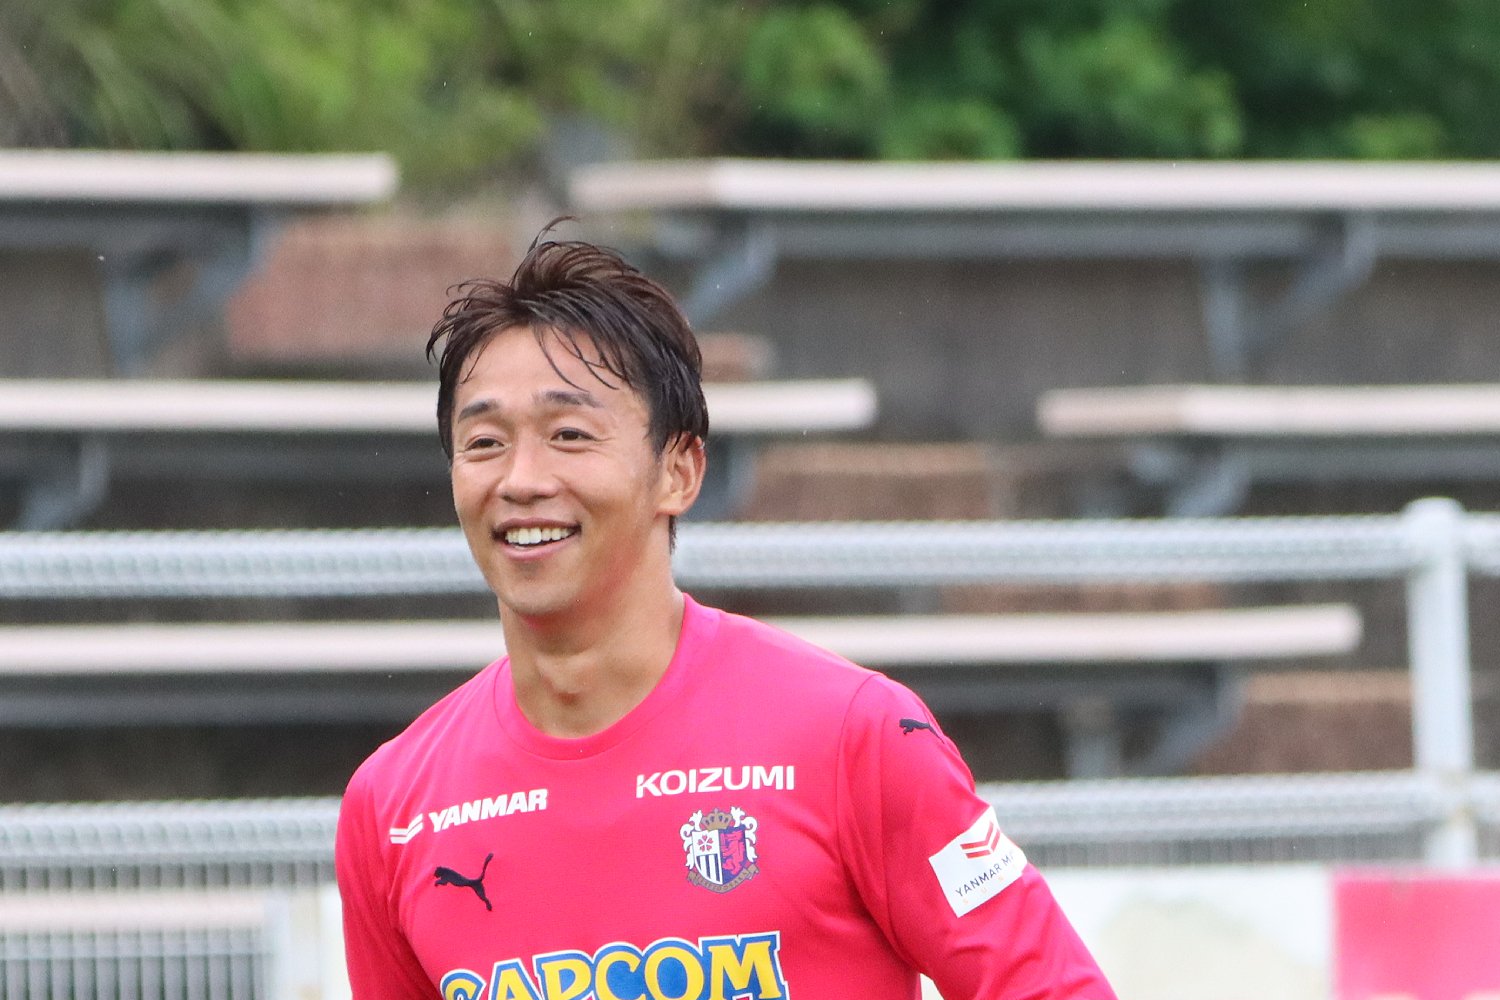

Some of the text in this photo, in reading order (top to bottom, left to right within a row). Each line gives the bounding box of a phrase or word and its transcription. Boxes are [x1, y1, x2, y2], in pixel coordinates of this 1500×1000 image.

[636, 765, 795, 799] KOIZUMI
[429, 788, 549, 833] YANMAR
[955, 862, 1002, 898] YANMAR
